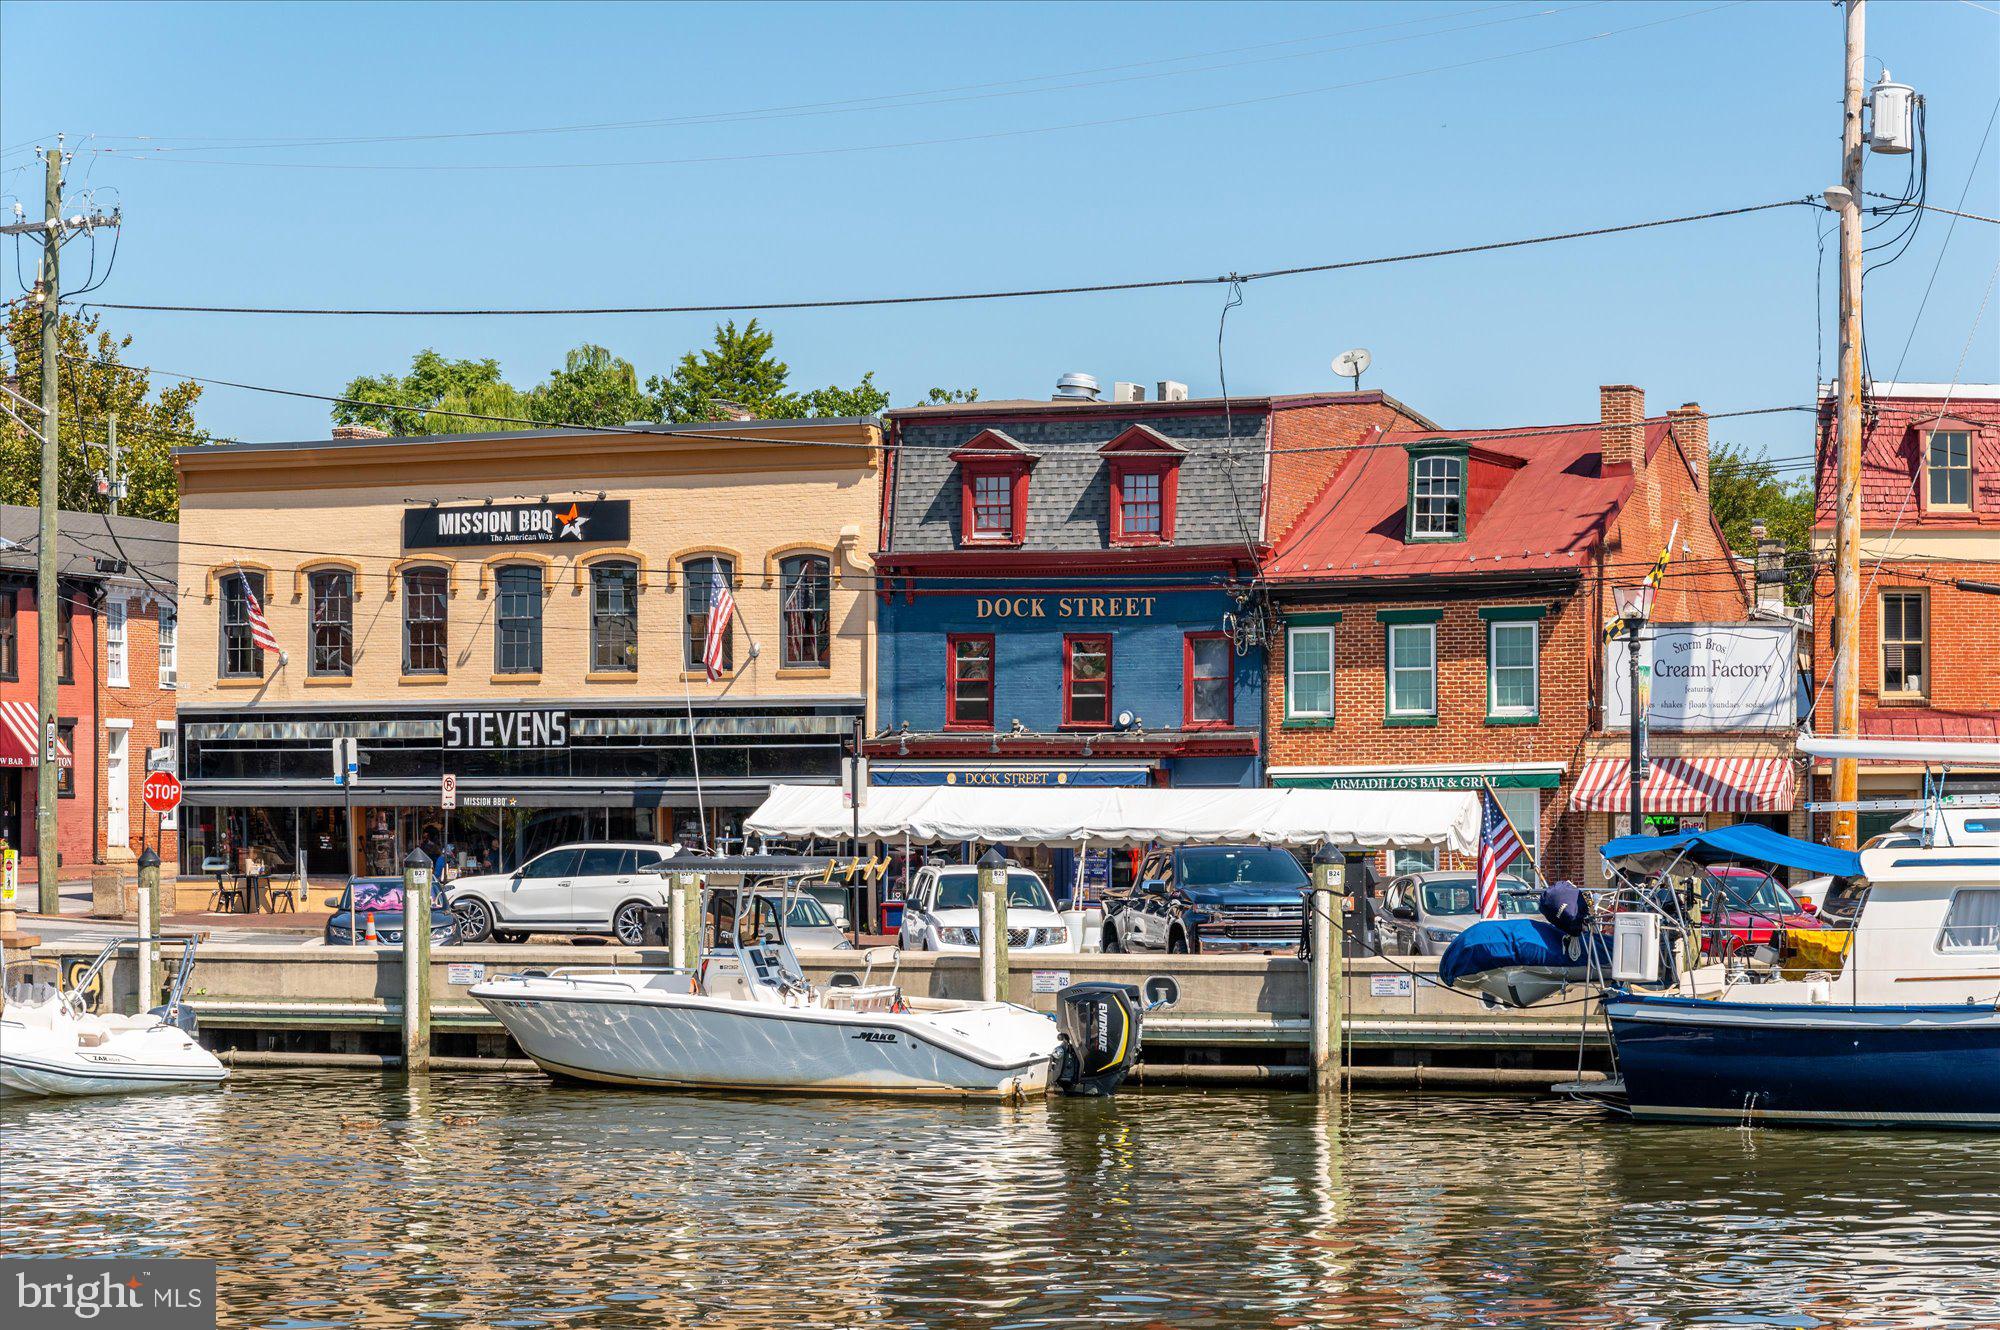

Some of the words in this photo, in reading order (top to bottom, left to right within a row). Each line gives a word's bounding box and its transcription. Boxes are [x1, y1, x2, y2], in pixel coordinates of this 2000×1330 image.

[438, 511, 512, 535] MISSION
[518, 509, 553, 534] BBQ
[491, 534, 503, 542] The
[504, 533, 537, 541] American
[537, 532, 554, 541] Way.
[976, 598, 1046, 618] DOCK
[1059, 597, 1156, 617] STREET
[1672, 640, 1702, 654] Storm
[1654, 659, 1707, 678] Cream
[1711, 659, 1772, 683] Factory
[1684, 685, 1714, 695] featuring
[1660, 700, 1683, 709] shakes
[1688, 700, 1708, 710] floats
[447, 711, 566, 747] STEVENS
[8, 757, 23, 765] BAR
[964, 772, 1000, 784] DOCK
[1003, 772, 1049, 784] STREET
[1330, 777, 1417, 789] ARMADILLO'S
[1420, 777, 1445, 788] BAR
[1447, 777, 1459, 788] &
[145, 783, 179, 800] STOP
[463, 797, 491, 806] MISSION
[492, 797, 507, 807] BBQ
[1644, 815, 1675, 825] ATM
[474, 969, 483, 979] B27
[1059, 976, 1069, 986] B25
[1399, 980, 1410, 990] B24
[1098, 1002, 1108, 1053] EVINRUDE
[855, 1031, 897, 1043] MAKO
